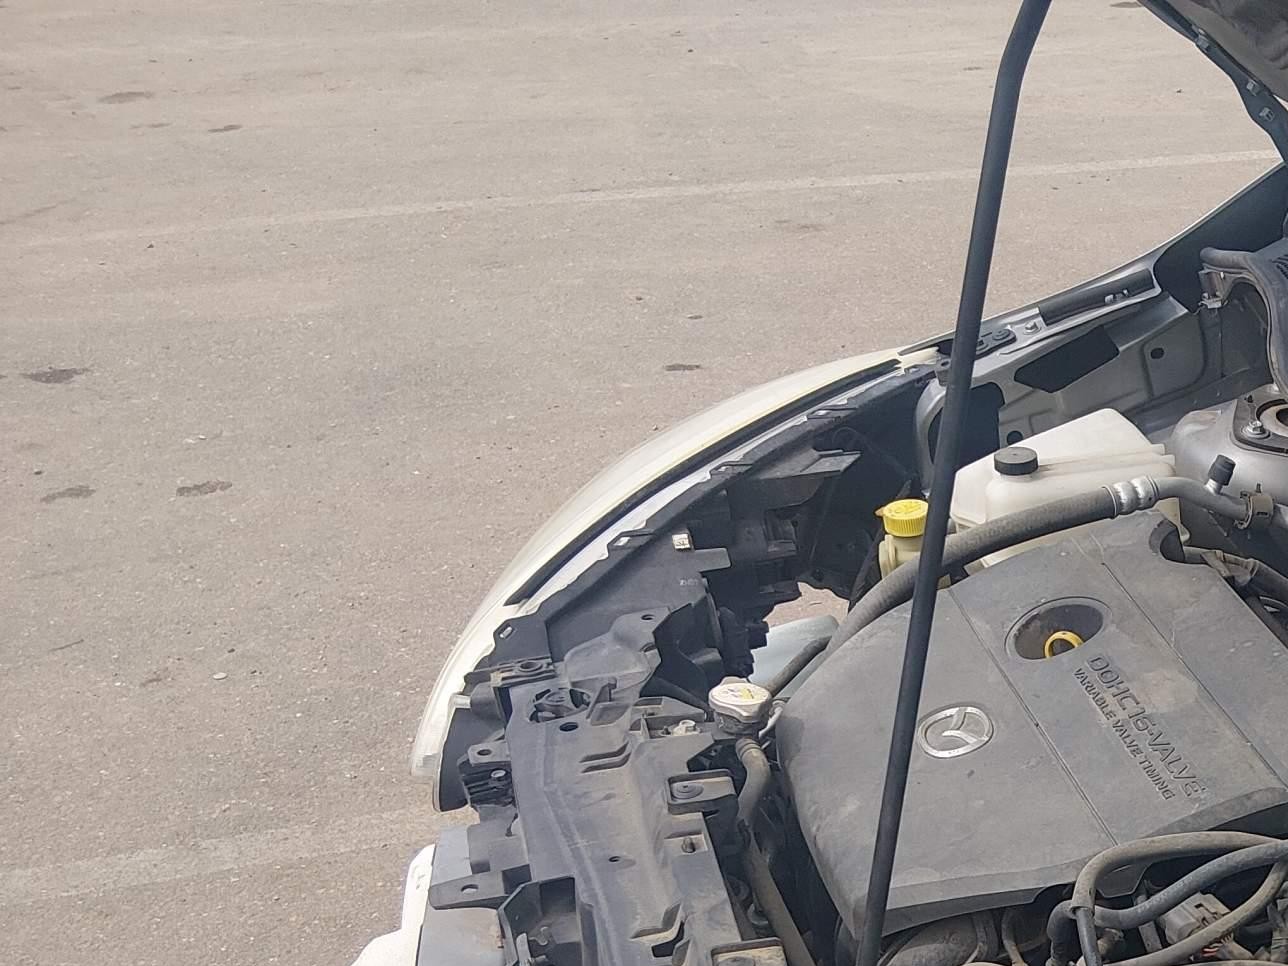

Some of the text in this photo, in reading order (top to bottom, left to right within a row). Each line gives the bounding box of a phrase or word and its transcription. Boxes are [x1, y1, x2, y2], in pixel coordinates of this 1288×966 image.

[1072, 667, 1176, 801] VARIABLE VALVE TIMING
[1087, 656, 1141, 711] DOHC
[1127, 707, 1207, 798] 16-VALVE
